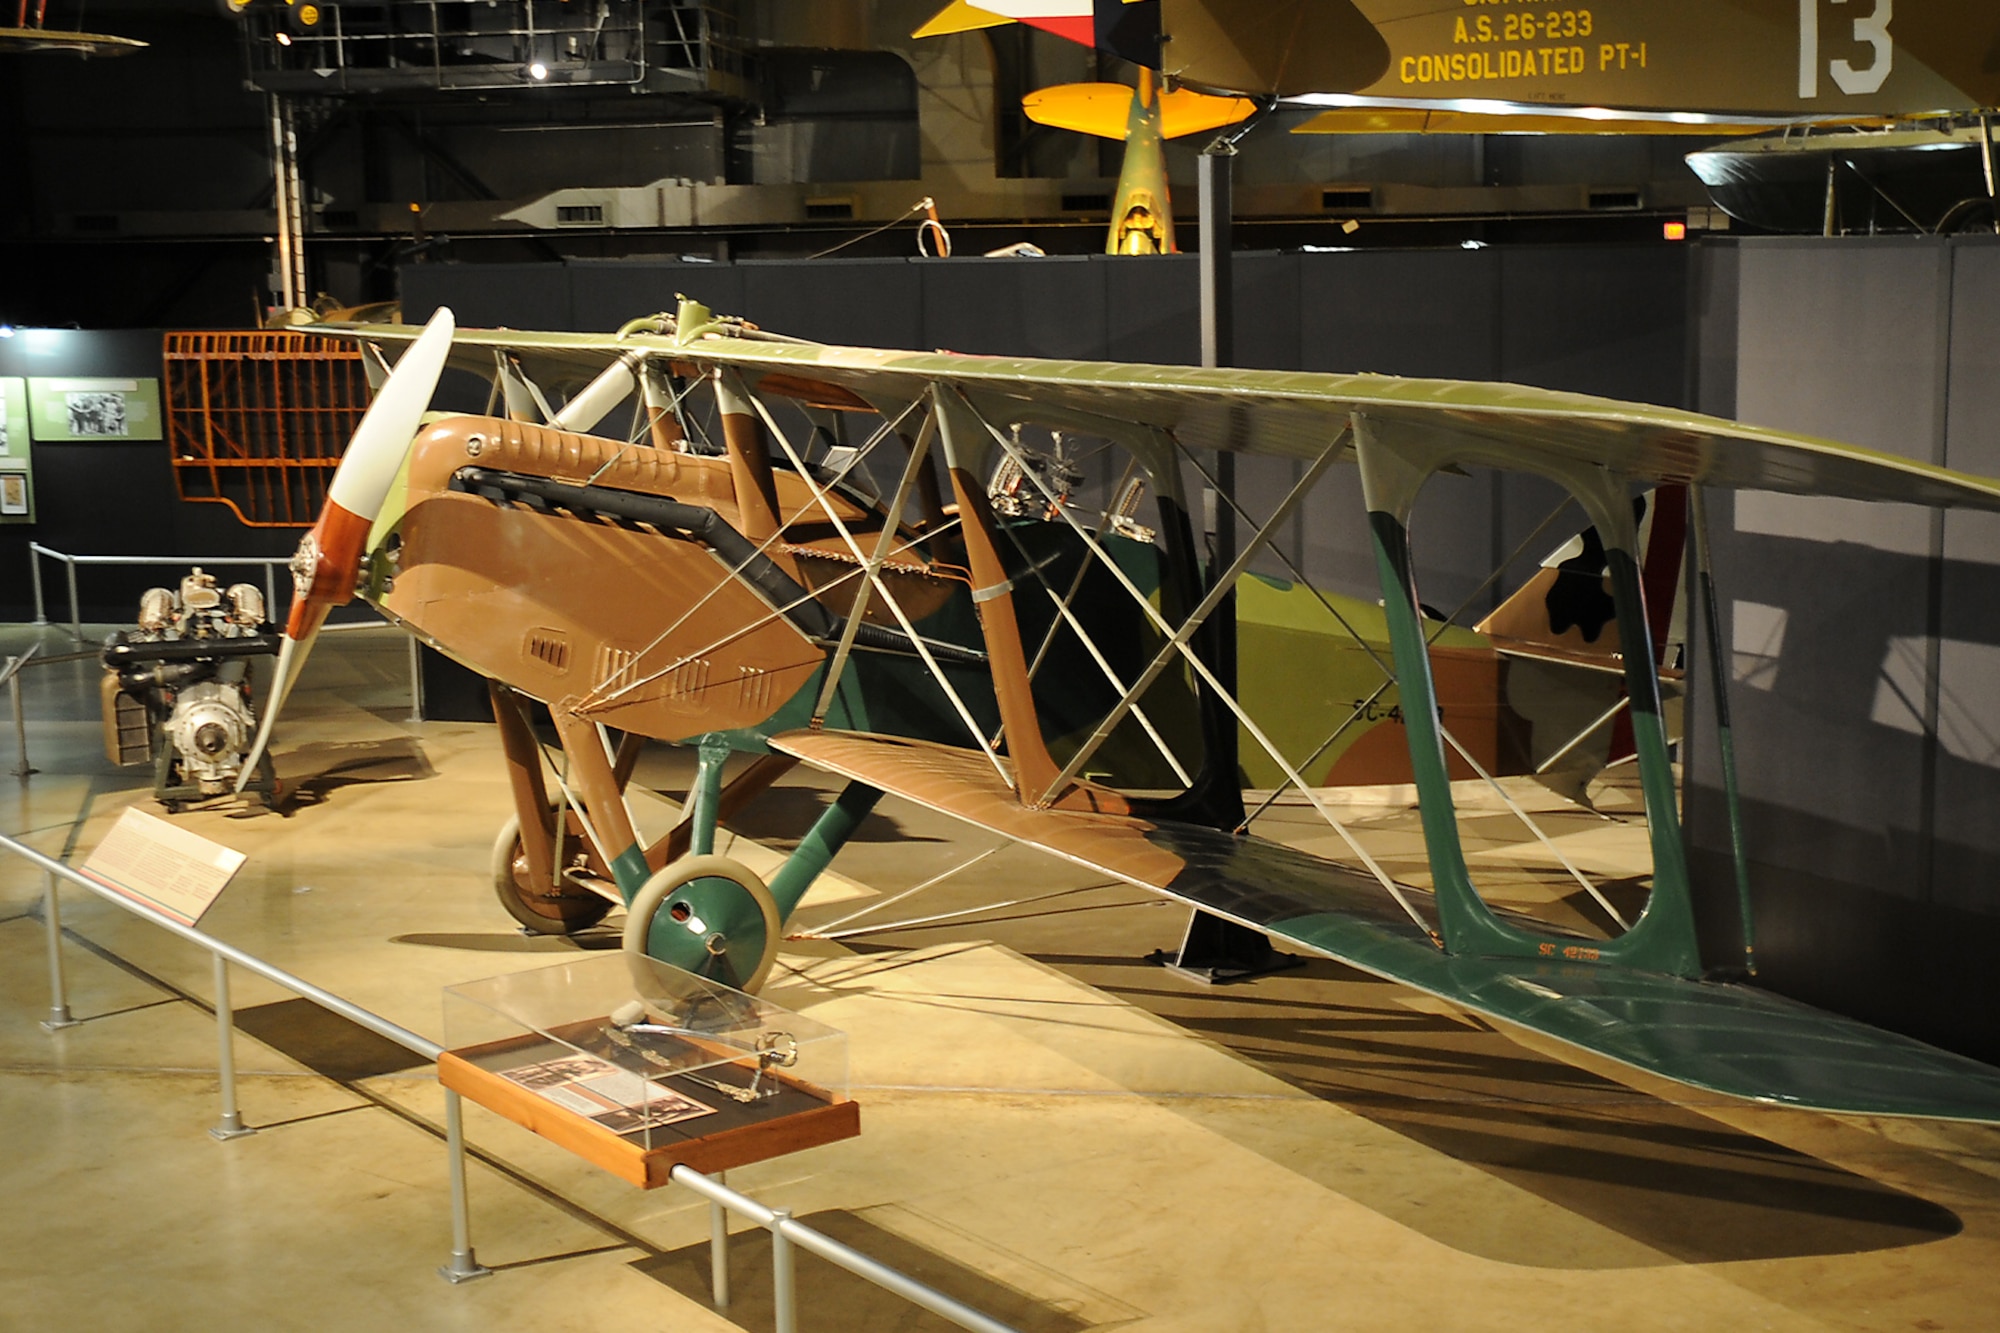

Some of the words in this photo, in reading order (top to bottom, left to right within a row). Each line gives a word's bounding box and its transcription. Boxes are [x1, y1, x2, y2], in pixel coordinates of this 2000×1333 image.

[1453, 15, 1500, 44] A.S.
[1504, 10, 1593, 41] 26-233
[1399, 46, 1585, 85] CONSOLIDATED
[1799, 0, 1893, 98] 13
